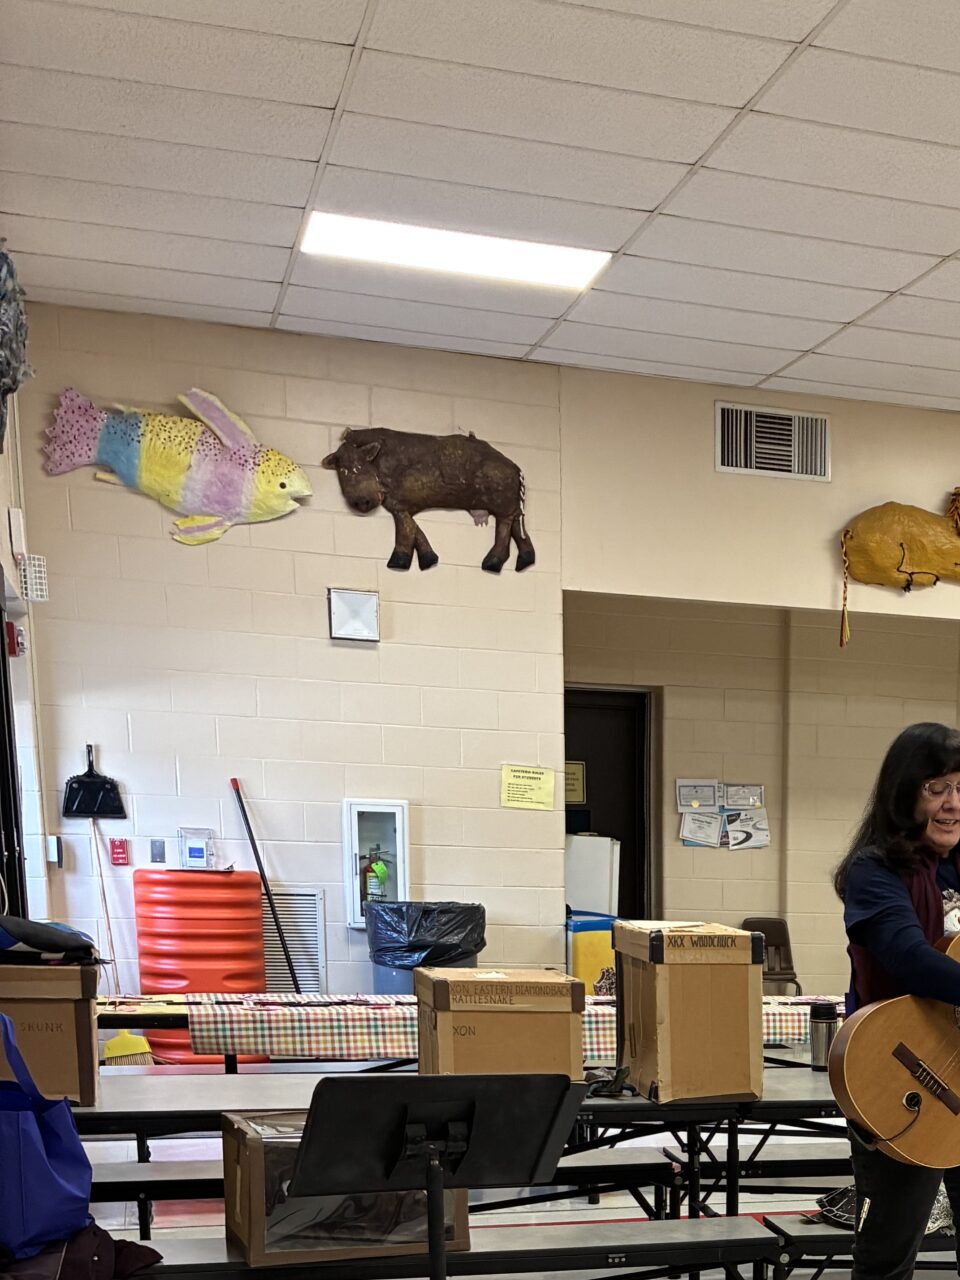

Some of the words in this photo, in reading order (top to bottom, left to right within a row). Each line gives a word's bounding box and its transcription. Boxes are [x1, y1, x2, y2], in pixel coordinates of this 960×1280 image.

[667, 935, 685, 947] XKX
[690, 935, 736, 948] WOODCHUCK
[451, 984, 469, 994] XON
[474, 984, 513, 995] EASTERN
[515, 985, 571, 997] DIAMONDBACK
[452, 995, 514, 1005] RATTLESNAKE
[20, 1022, 63, 1032] SKUNK
[452, 1025, 476, 1036] XON
